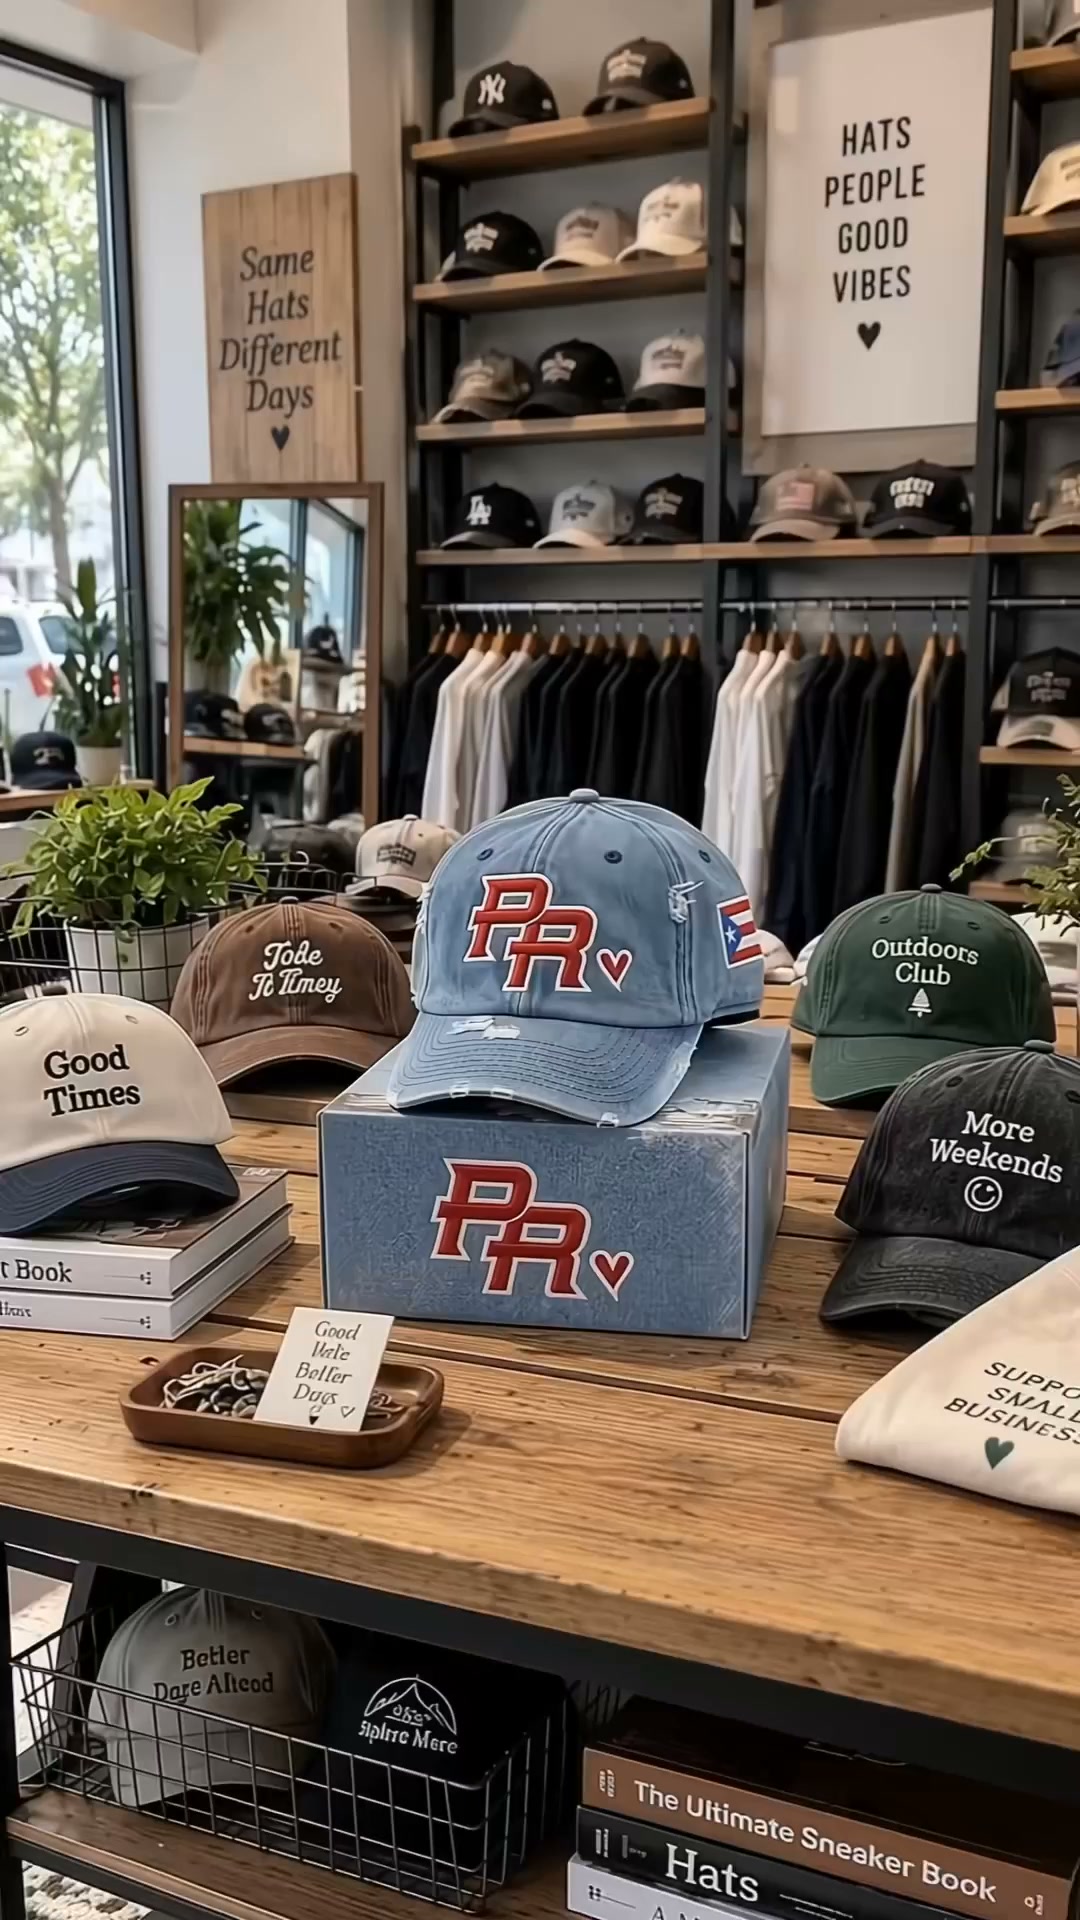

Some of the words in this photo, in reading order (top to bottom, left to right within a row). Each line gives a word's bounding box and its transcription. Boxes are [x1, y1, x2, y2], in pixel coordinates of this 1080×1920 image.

[478, 74, 506, 106] NY
[842, 116, 912, 156] HATS
[825, 164, 926, 207] PEOPLE
[839, 216, 908, 254] GOOD
[240, 246, 314, 281] Same
[834, 265, 911, 303] VIBES
[247, 290, 309, 325] Hats
[220, 330, 341, 376] Different
[246, 379, 313, 419] Days
[466, 495, 491, 526] LA
[463, 873, 598, 992] PR
[871, 935, 979, 966] Outdoors
[895, 962, 951, 986] Club
[43, 1044, 130, 1080] Good
[43, 1084, 141, 1117] Times
[961, 1111, 1036, 1143] More
[930, 1138, 1063, 1184] Weekends
[430, 1158, 591, 1300] PR
[15, 1259, 72, 1283] Book
[315, 1321, 362, 1341] Good
[634, 1779, 679, 1811] The
[686, 1795, 794, 1844] Ultimate
[801, 1826, 915, 1878] Sneaker
[922, 1860, 997, 1903] Book
[665, 1843, 759, 1902] Hats
